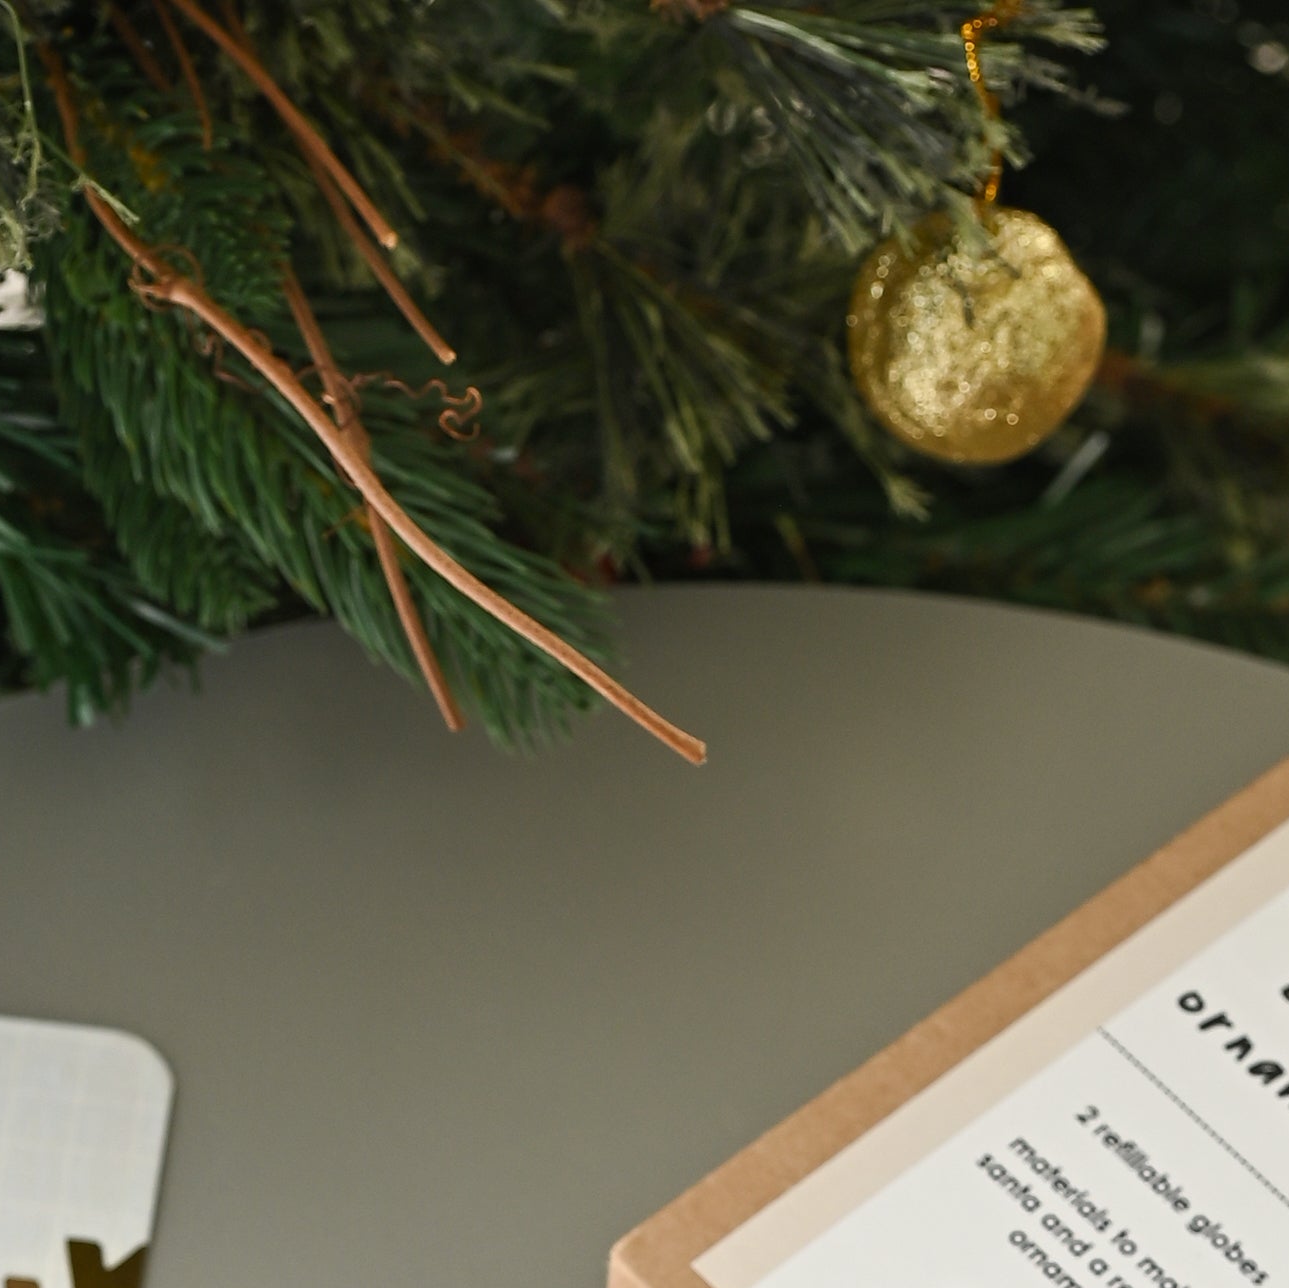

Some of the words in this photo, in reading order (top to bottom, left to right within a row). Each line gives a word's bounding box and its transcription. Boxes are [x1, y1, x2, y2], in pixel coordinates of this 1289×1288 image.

[975, 1152, 1042, 1214] santa
[1039, 1213, 1094, 1257] and
[1087, 1257, 1110, 1276] a
[1007, 1136, 1113, 1233] materials
[1109, 1228, 1138, 1257] to
[1074, 1104, 1100, 1126] 2
[1092, 1123, 1191, 1213] refillable
[1184, 1213, 1269, 1286] globes
